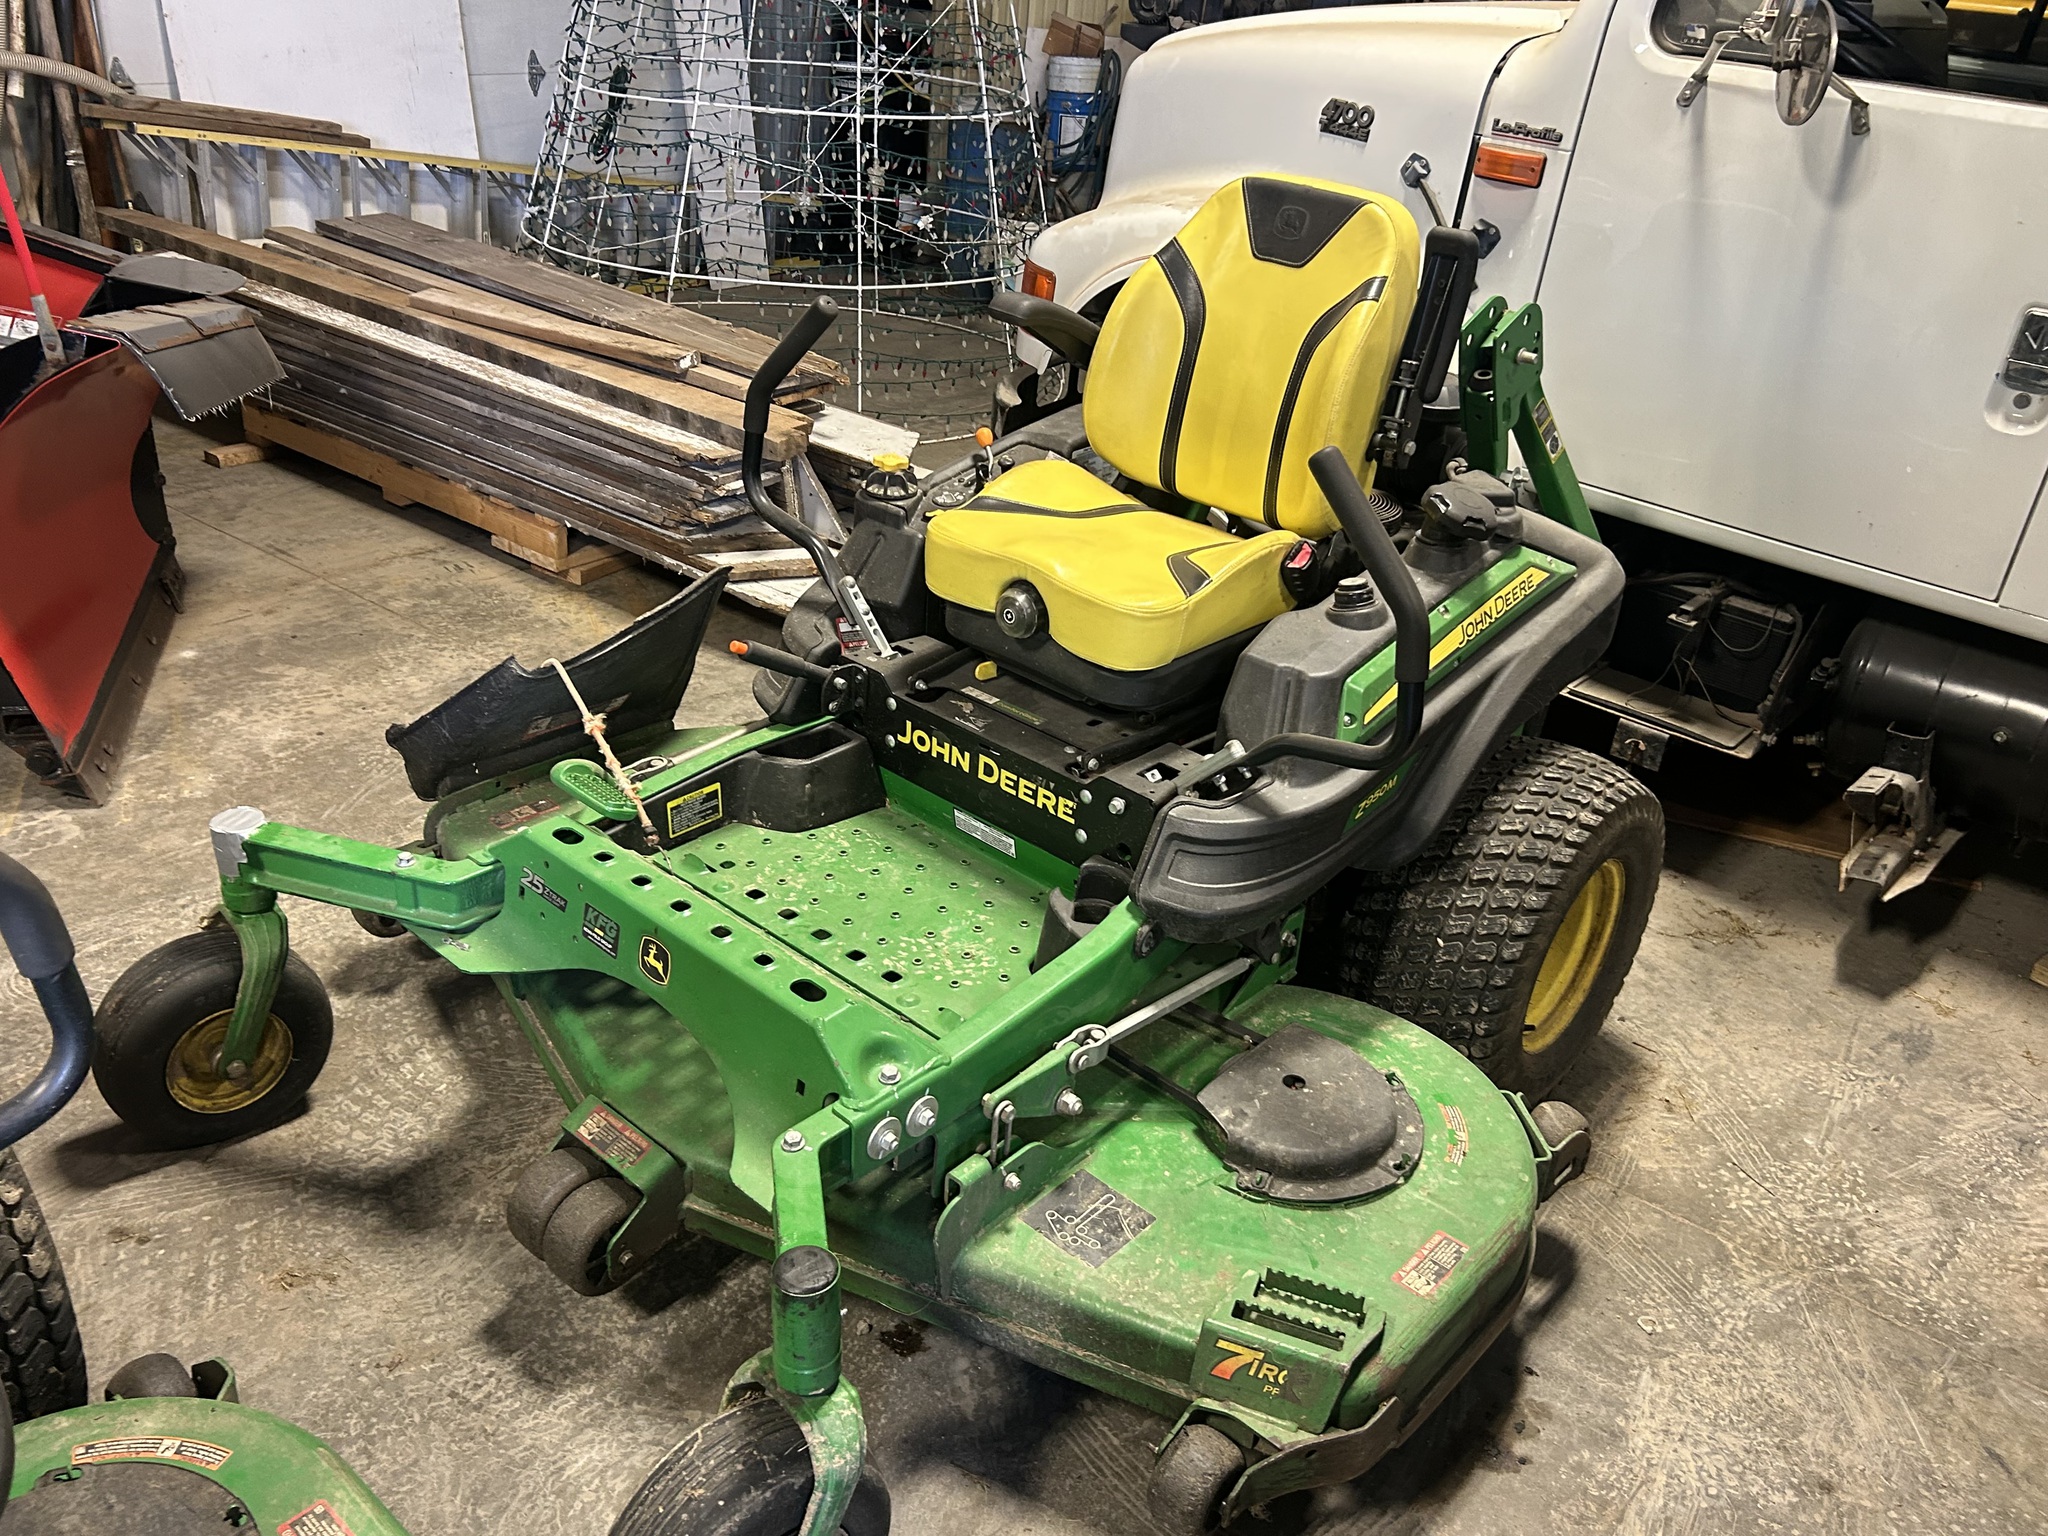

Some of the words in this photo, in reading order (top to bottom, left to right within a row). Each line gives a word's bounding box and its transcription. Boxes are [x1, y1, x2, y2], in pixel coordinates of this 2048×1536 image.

[1321, 98, 1375, 128] 4700
[1492, 118, 1563, 142] Lo-Profile
[1459, 606, 1493, 645] JOHN
[1494, 573, 1535, 615] DEERE
[897, 720, 970, 773] JOHN
[978, 753, 1076, 825] DEERE
[520, 866, 544, 894] 25
[585, 906, 619, 939] KFG
